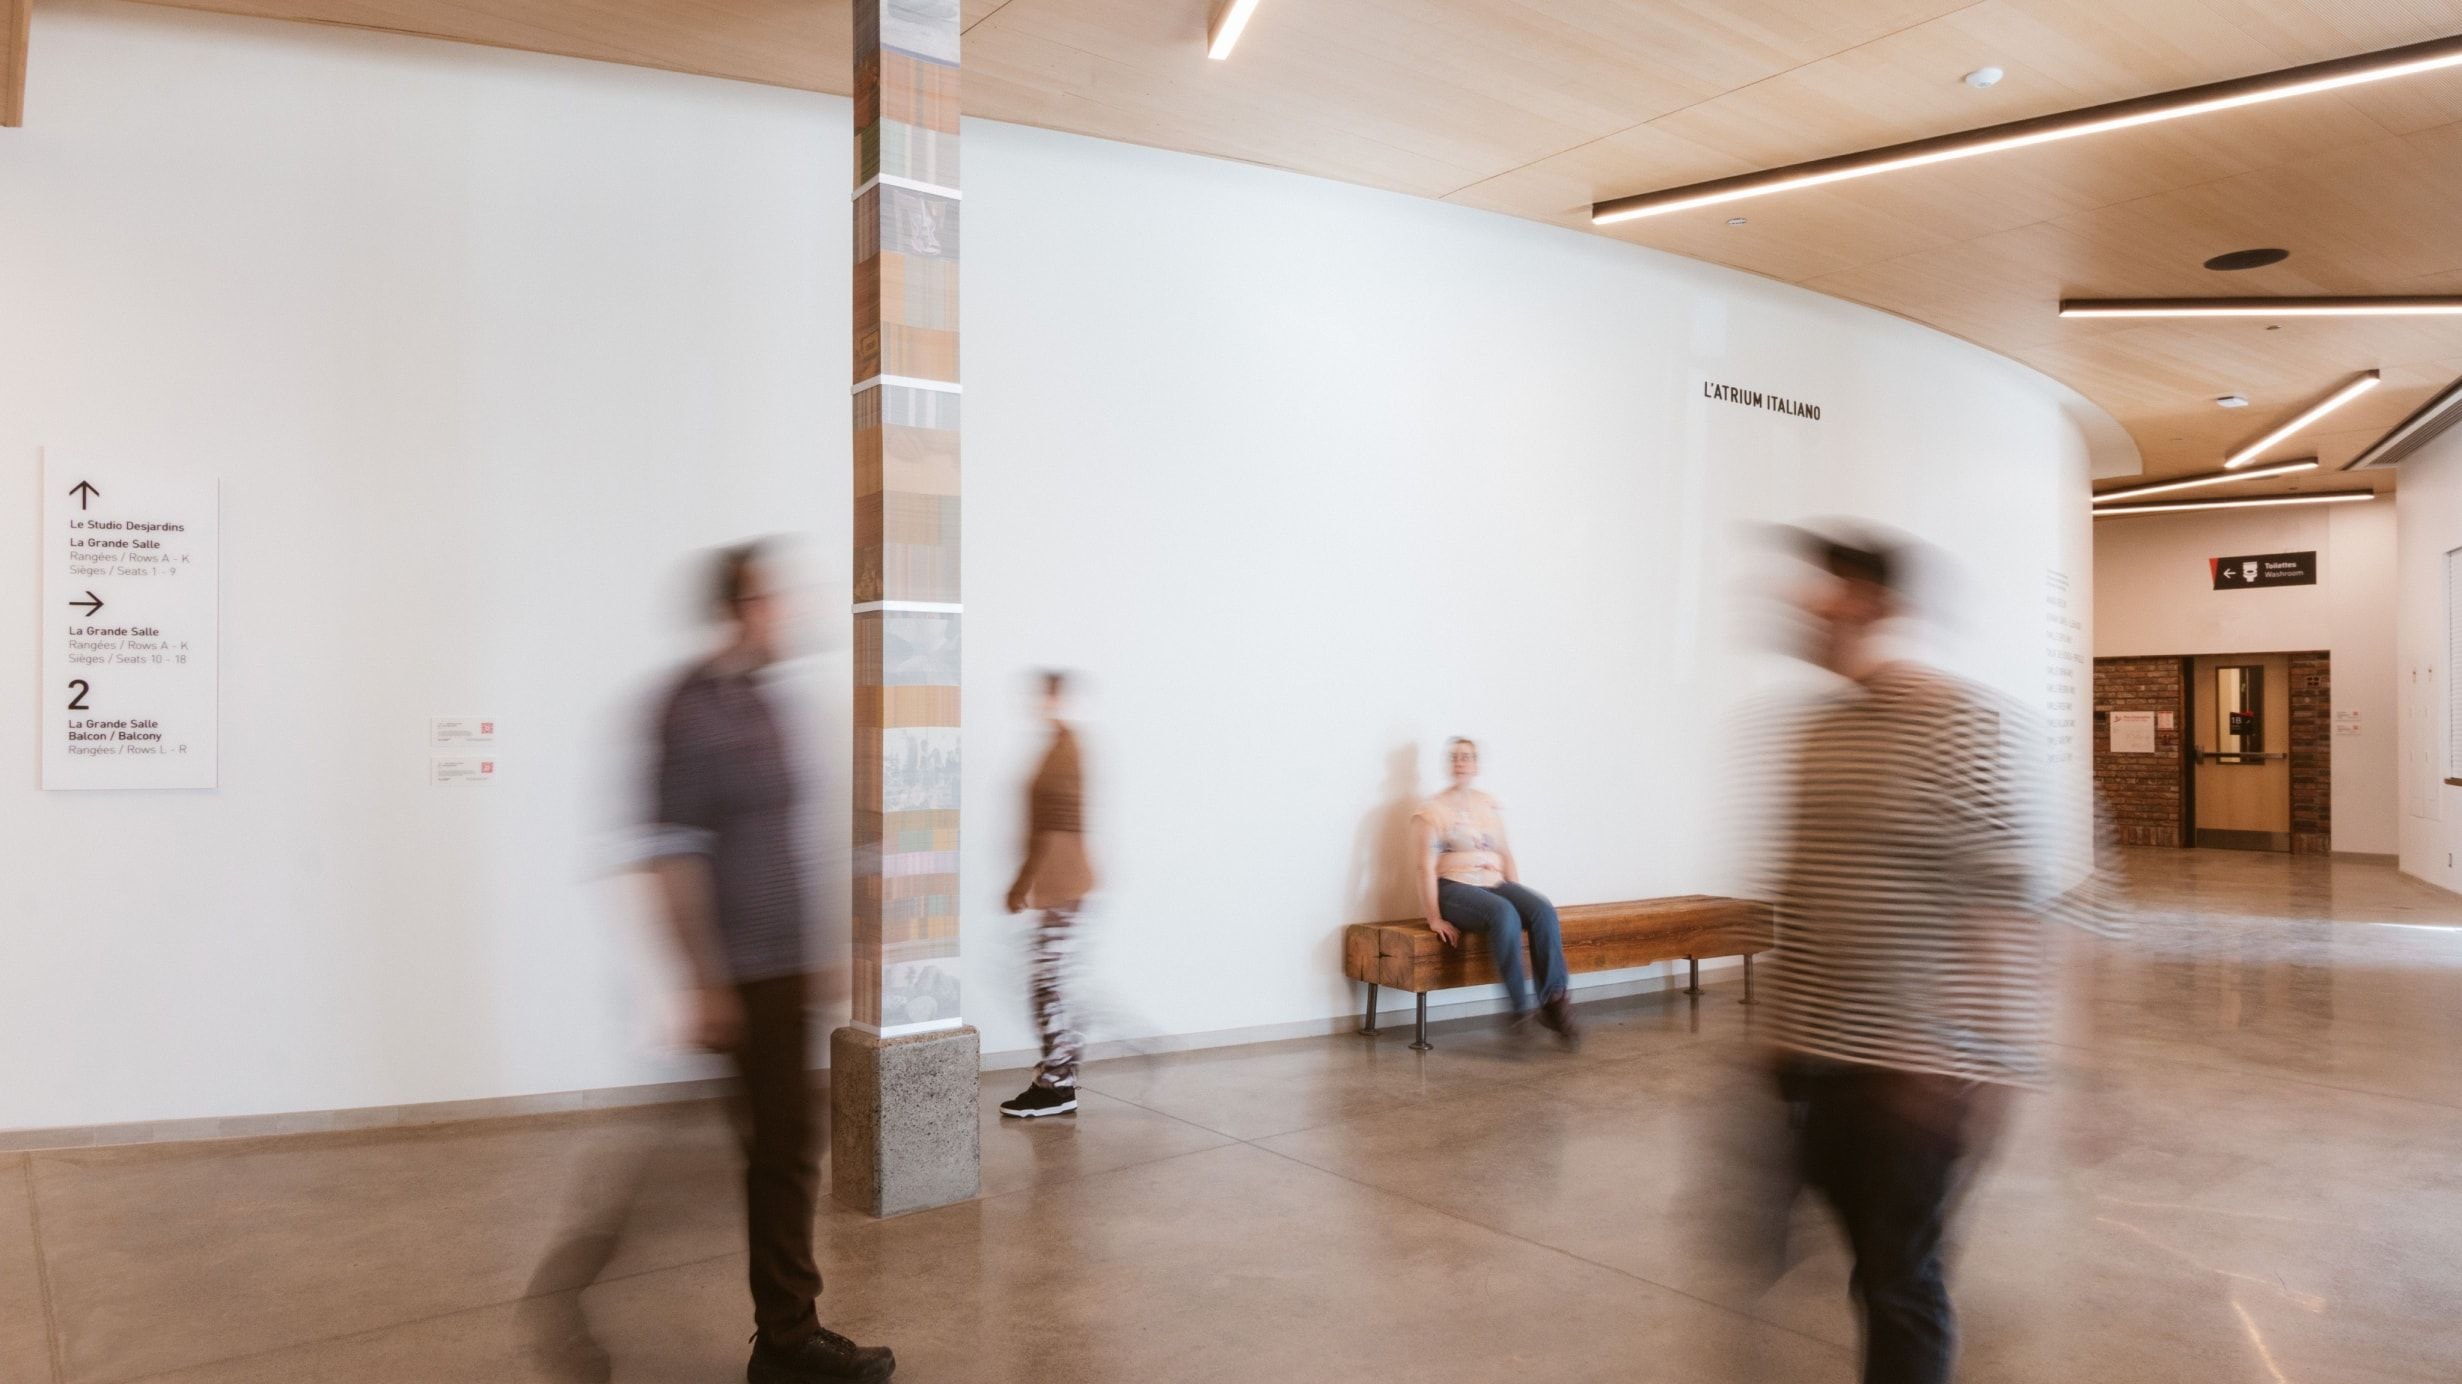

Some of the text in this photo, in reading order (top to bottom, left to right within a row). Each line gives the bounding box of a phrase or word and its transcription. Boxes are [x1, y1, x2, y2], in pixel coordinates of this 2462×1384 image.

[1704, 381, 1820, 421] L'ATRIUM ITALIANO
[70, 520, 185, 533] Le Studio Desjardins
[70, 538, 161, 549] La Grande Salle
[129, 553, 159, 563] Rows
[162, 554, 170, 563] A
[182, 555, 191, 563] K
[117, 566, 148, 576] Seats
[169, 567, 177, 576] 9
[2264, 562, 2297, 570] Toilettes
[69, 626, 160, 636] La Grande Salle
[128, 641, 158, 650] Rows
[160, 641, 168, 650] A
[180, 641, 189, 650] K
[116, 654, 147, 664] Seats
[151, 655, 163, 664] 10
[175, 655, 187, 664] 18
[68, 679, 90, 710] 2
[69, 719, 158, 729] La Grande Salle
[69, 731, 162, 742] Balcon / Balcony
[127, 745, 157, 754] Rows
[160, 745, 167, 754] L
[179, 744, 188, 754] R
